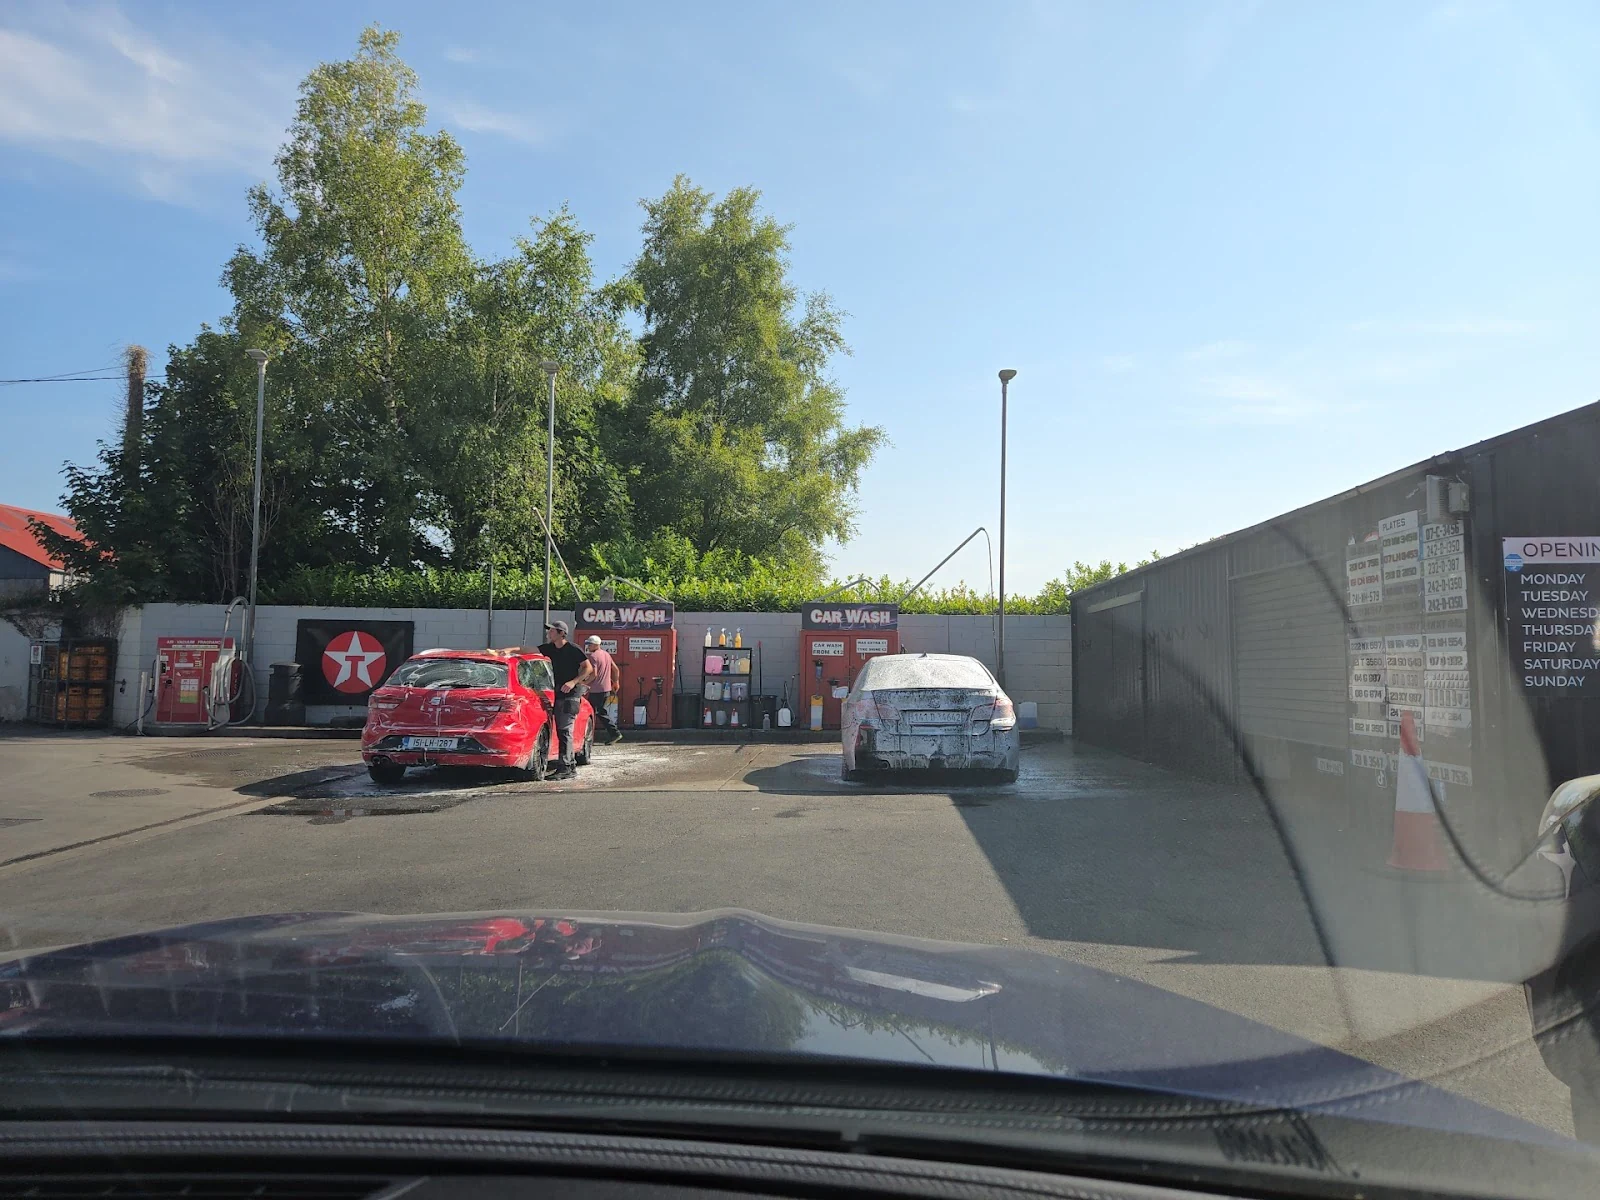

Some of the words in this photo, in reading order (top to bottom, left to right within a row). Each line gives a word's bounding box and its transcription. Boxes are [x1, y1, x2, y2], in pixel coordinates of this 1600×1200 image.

[1382, 518, 1406, 531] PLATES
[1520, 573, 1586, 585] MONDAY
[1521, 590, 1589, 602] TUESDAY
[582, 607, 616, 623] CAR
[618, 607, 666, 623] WASH
[810, 608, 842, 624] CAR
[844, 609, 891, 624] WASH
[1521, 607, 1600, 619] WEDNESD
[1522, 624, 1600, 636] THURSDAY
[1523, 641, 1576, 653] FRIDAY
[1524, 658, 1600, 670] SATURDAY
[1525, 675, 1586, 687] SUNDAY
[412, 739, 453, 748] 151-LH-1287
